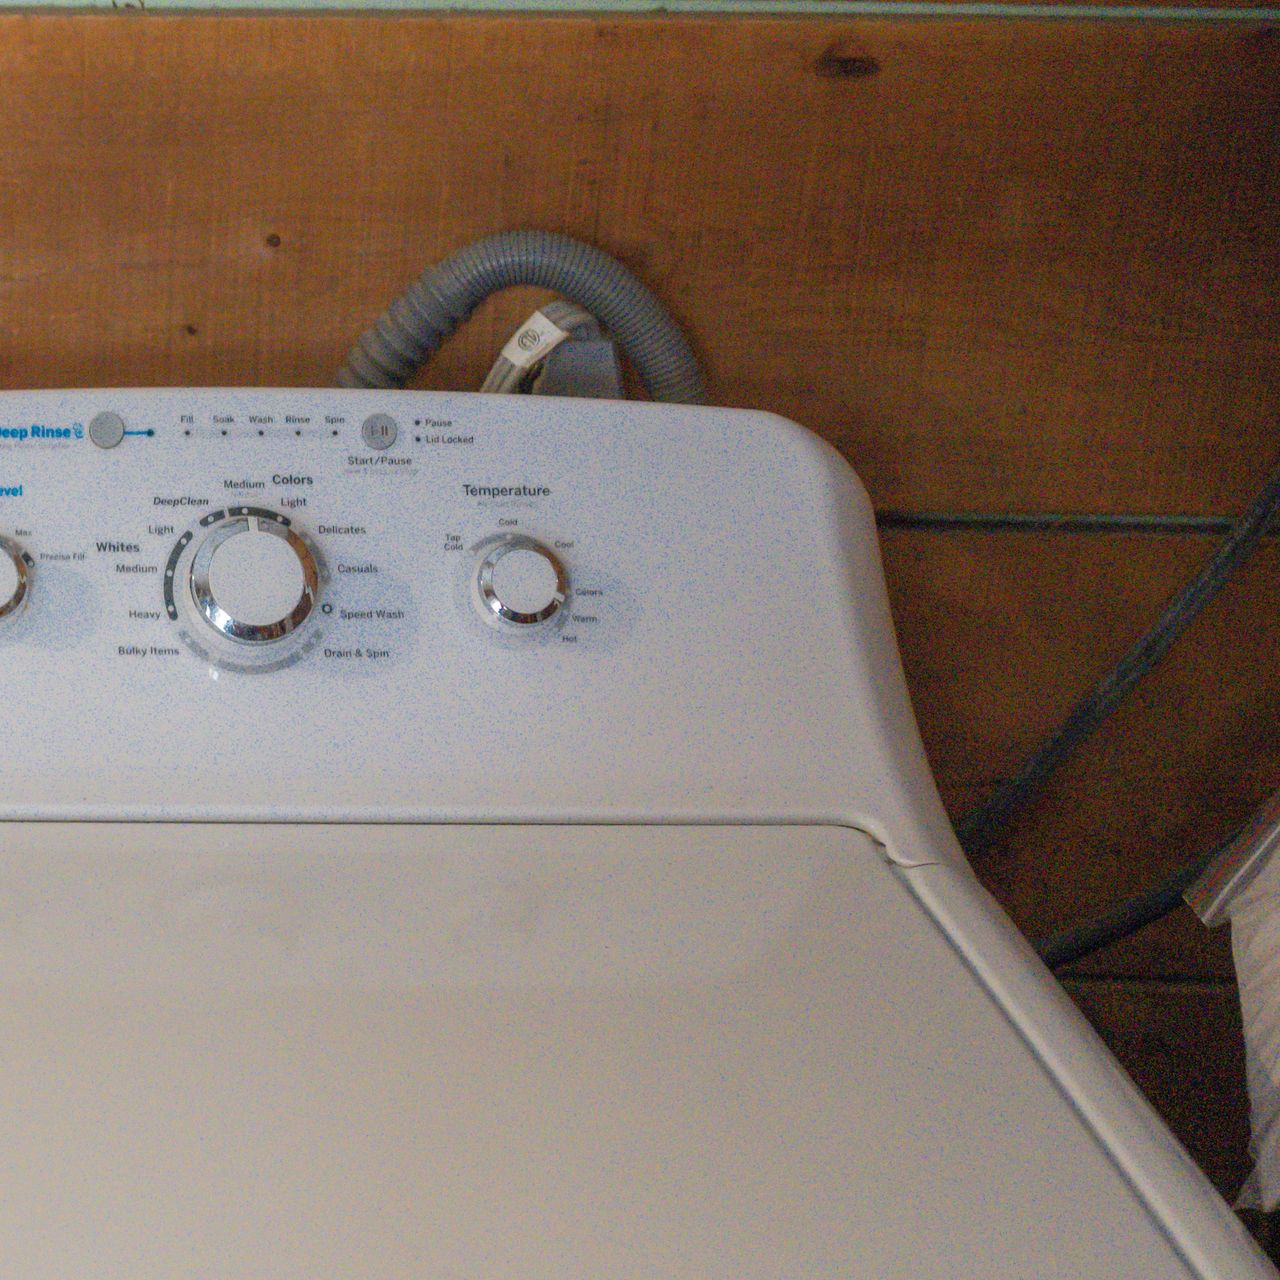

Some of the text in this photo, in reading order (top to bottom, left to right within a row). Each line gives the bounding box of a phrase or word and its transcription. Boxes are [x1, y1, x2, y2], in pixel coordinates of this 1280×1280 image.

[180, 414, 195, 424] Fill
[212, 415, 235, 424] Soak
[248, 415, 274, 424] Wash
[285, 415, 310, 424] Rinse
[324, 415, 345, 426] Spin
[425, 418, 452, 427] Pause
[30, 425, 71, 438] Rinse
[425, 434, 474, 444] Lid Locked
[348, 456, 412, 466] Start/Pause
[224, 479, 265, 489] Medium
[272, 474, 313, 486] Colors
[463, 484, 550, 498] Temperature
[153, 496, 209, 508] DeepClean
[280, 497, 307, 509] Light
[498, 518, 518, 527] Cold
[148, 525, 174, 536] Light
[318, 525, 366, 535] Delicates
[445, 534, 461, 544] Tap
[96, 542, 140, 553] Whites
[444, 543, 463, 551] Cold
[554, 540, 575, 549] Cool
[39, 552, 86, 561] Precise Fill
[116, 564, 157, 574] Medium
[337, 564, 378, 574] Casuals
[575, 587, 603, 597] Colors
[129, 610, 160, 621] Heavy
[340, 610, 405, 621] Speed Wash
[571, 614, 598, 624] Warm
[562, 634, 577, 643] Hot
[118, 646, 180, 658] Bulky Items
[324, 648, 389, 660] Drain & Spin
